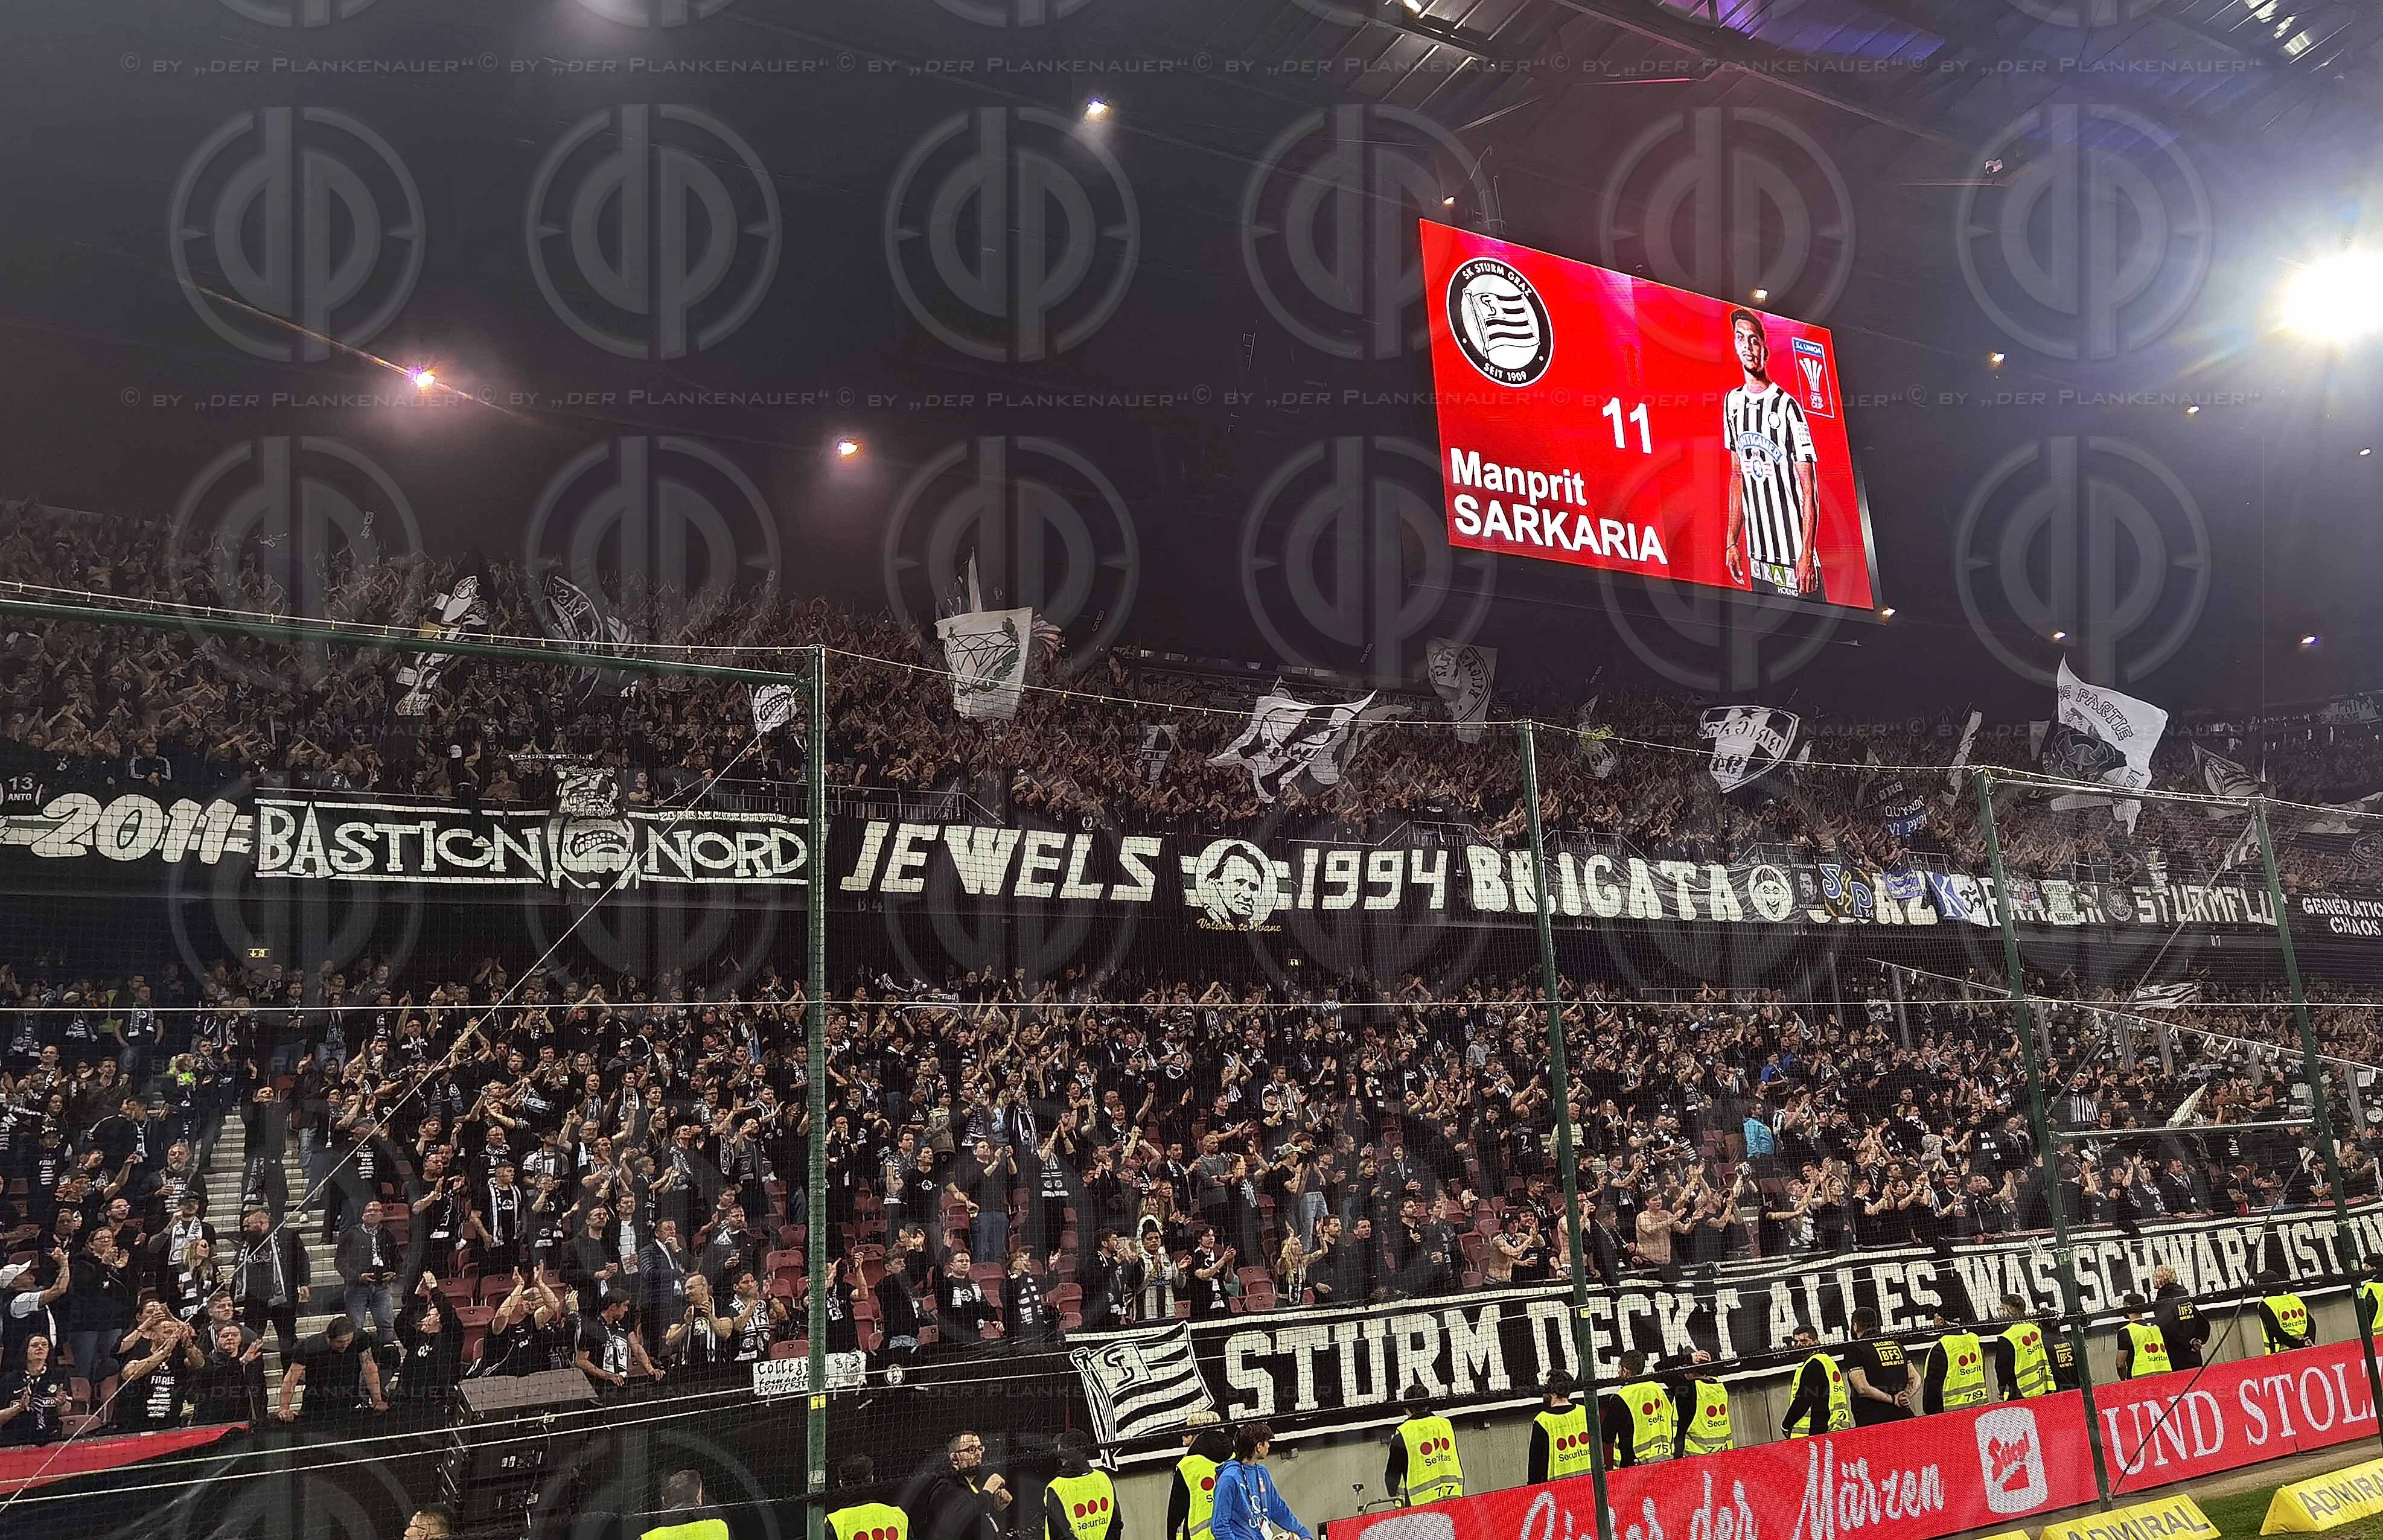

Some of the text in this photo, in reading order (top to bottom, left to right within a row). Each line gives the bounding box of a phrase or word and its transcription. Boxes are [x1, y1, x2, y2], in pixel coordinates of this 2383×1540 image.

[1462, 262, 1534, 298] SK STURM GRAZ
[1484, 362, 1527, 381] SEIT 1909
[1602, 396, 1652, 454] 11
[1450, 447, 1588, 507] Manprit
[1453, 493, 1669, 565] SARKARIA
[1751, 559, 1797, 589] GRAZ
[2075, 688, 2134, 742] PARTIE
[31, 792, 238, 865] 2011
[645, 825, 808, 882] NORD
[840, 821, 1162, 902] JEWELS
[1297, 848, 1448, 910] 1994
[1466, 846, 1744, 922] BRIGATA
[2329, 916, 2382, 937] CHAOS
[1224, 1303, 1512, 1422] STURM
[1768, 1259, 1944, 1351] ALLES
[1954, 1253, 2066, 1322] WAS
[2072, 1226, 2266, 1314] SCHWARZ
[2276, 1220, 2344, 1281] IST
[1882, 1349, 1903, 1361] BFS
[2102, 1392, 2225, 1477] UND
[1790, 1438, 1946, 1540] Märzen
